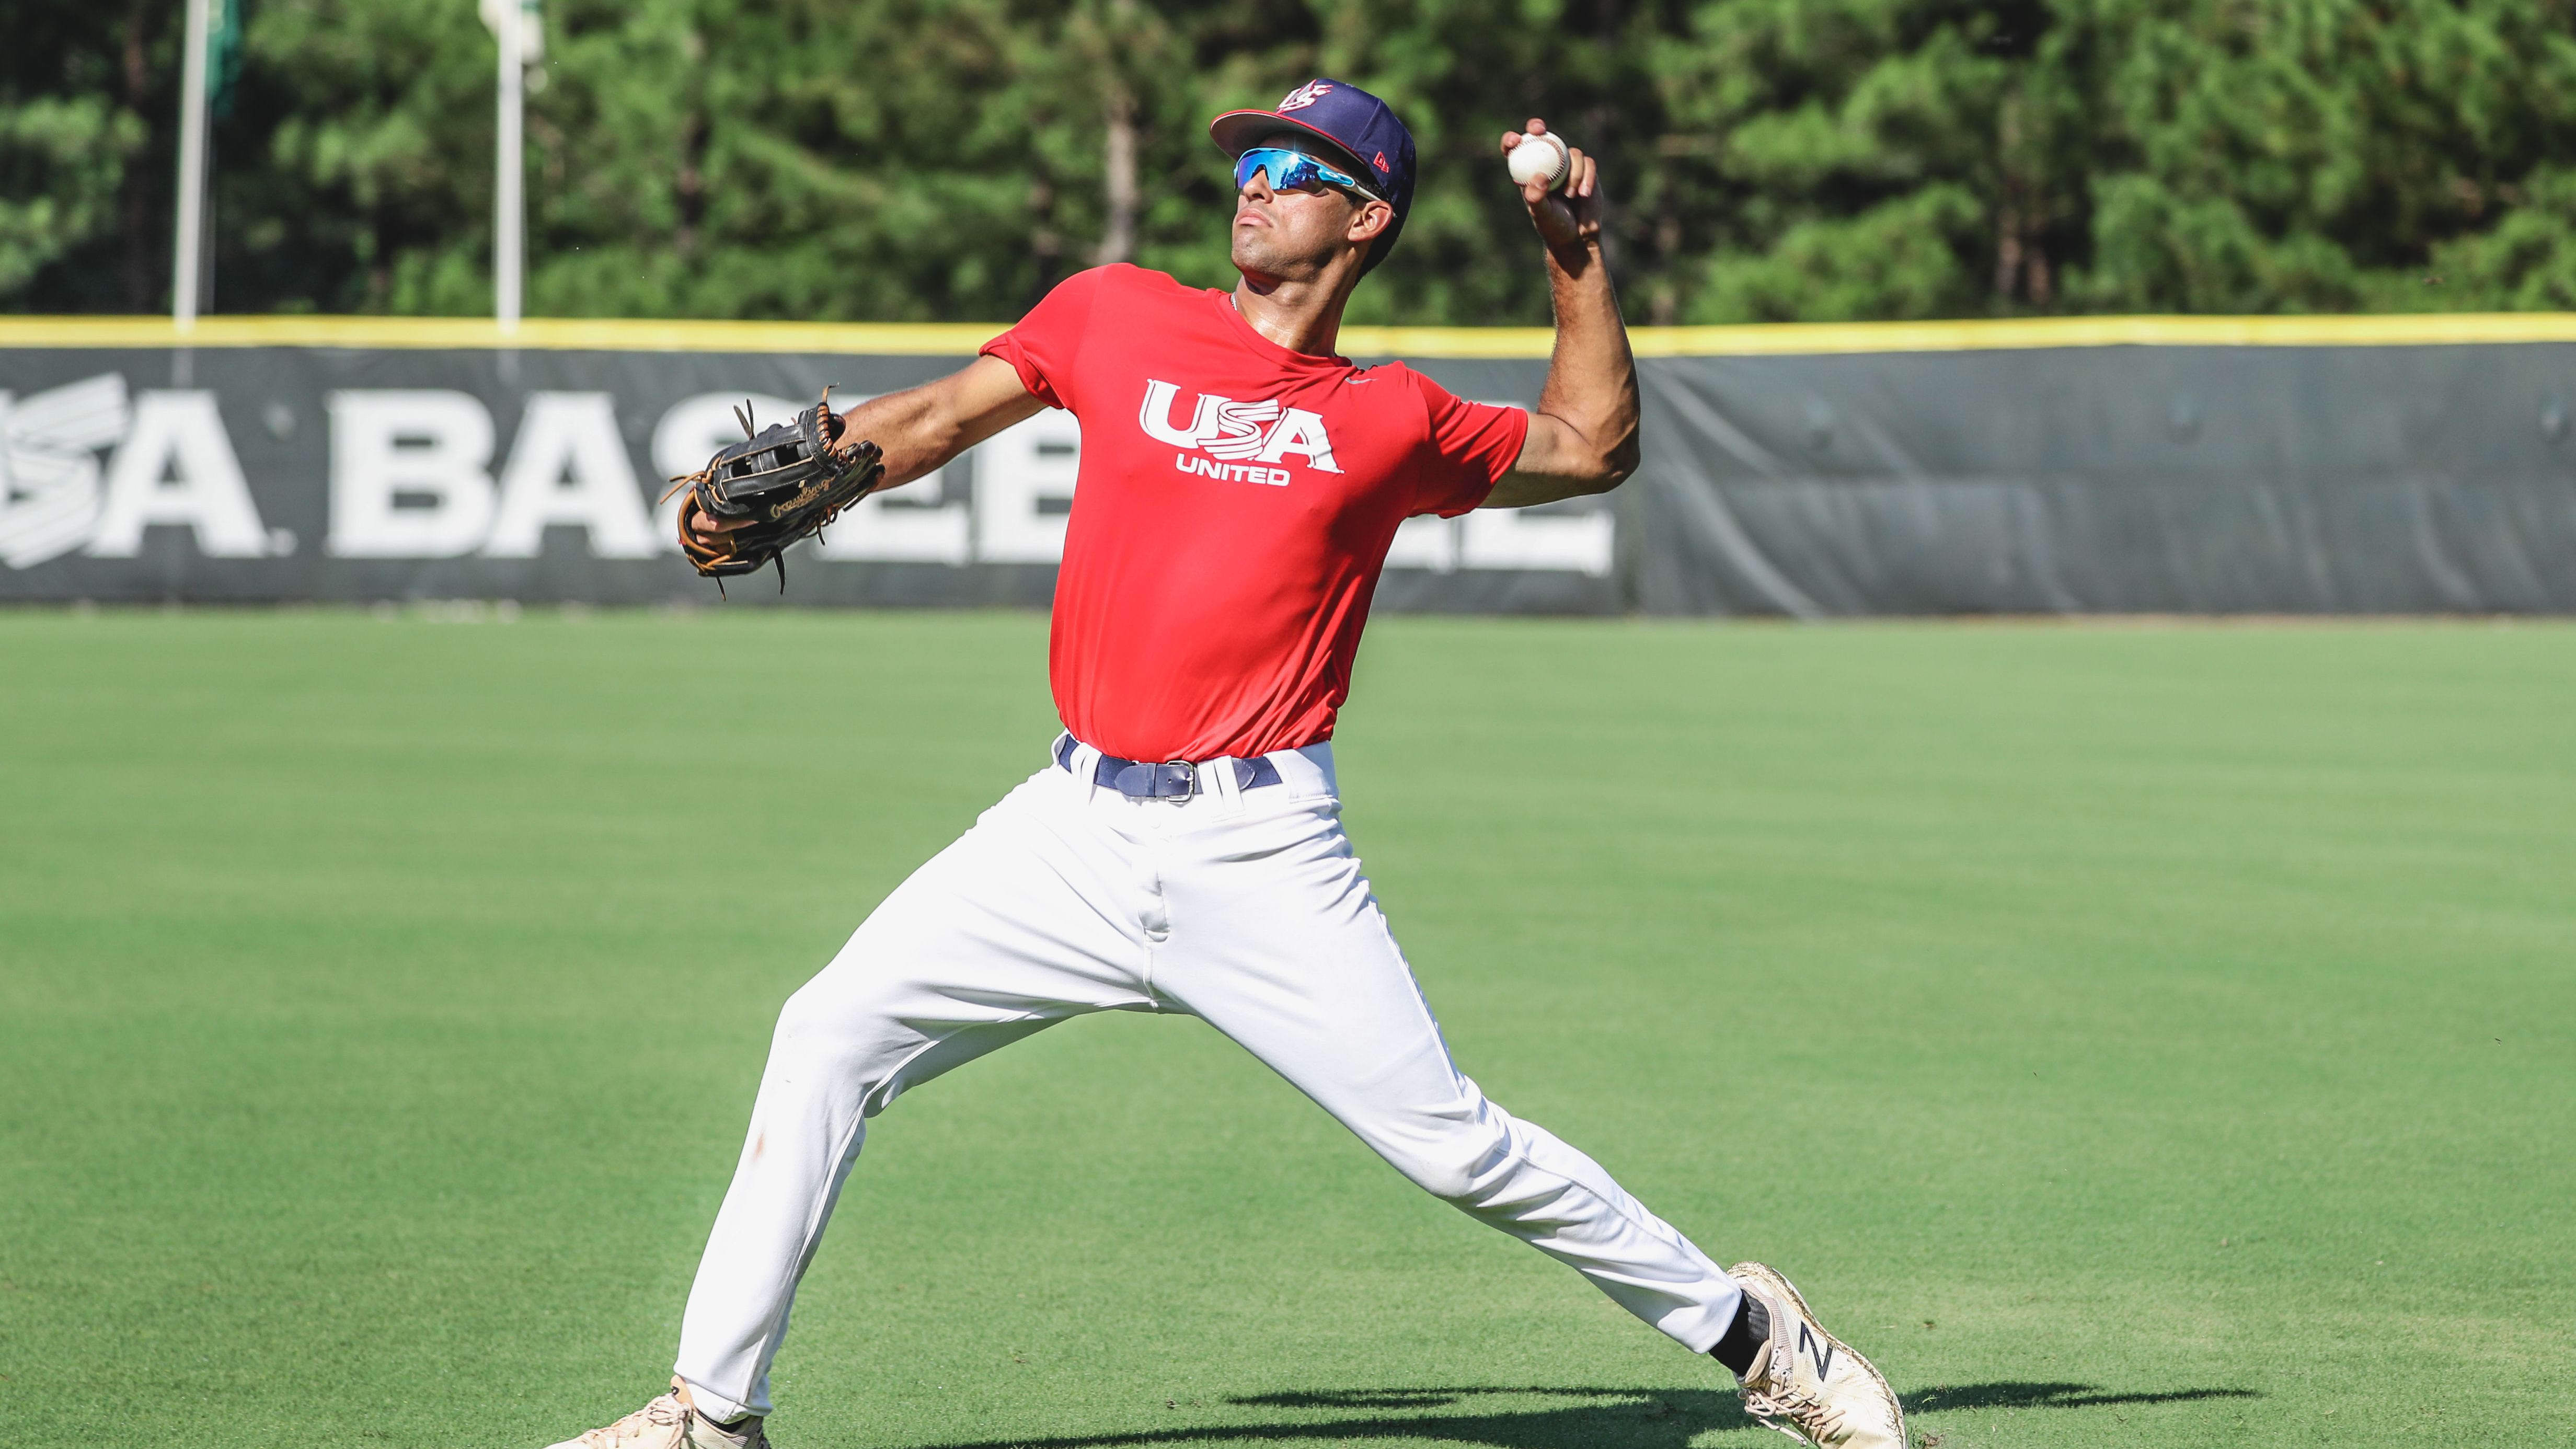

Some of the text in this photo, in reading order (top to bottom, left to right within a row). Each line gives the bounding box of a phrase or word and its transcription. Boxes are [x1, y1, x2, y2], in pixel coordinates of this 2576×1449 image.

[0, 371, 1616, 577] SA BAEBL
[1138, 378, 1344, 474] USA
[1175, 453, 1291, 487] UNITED
